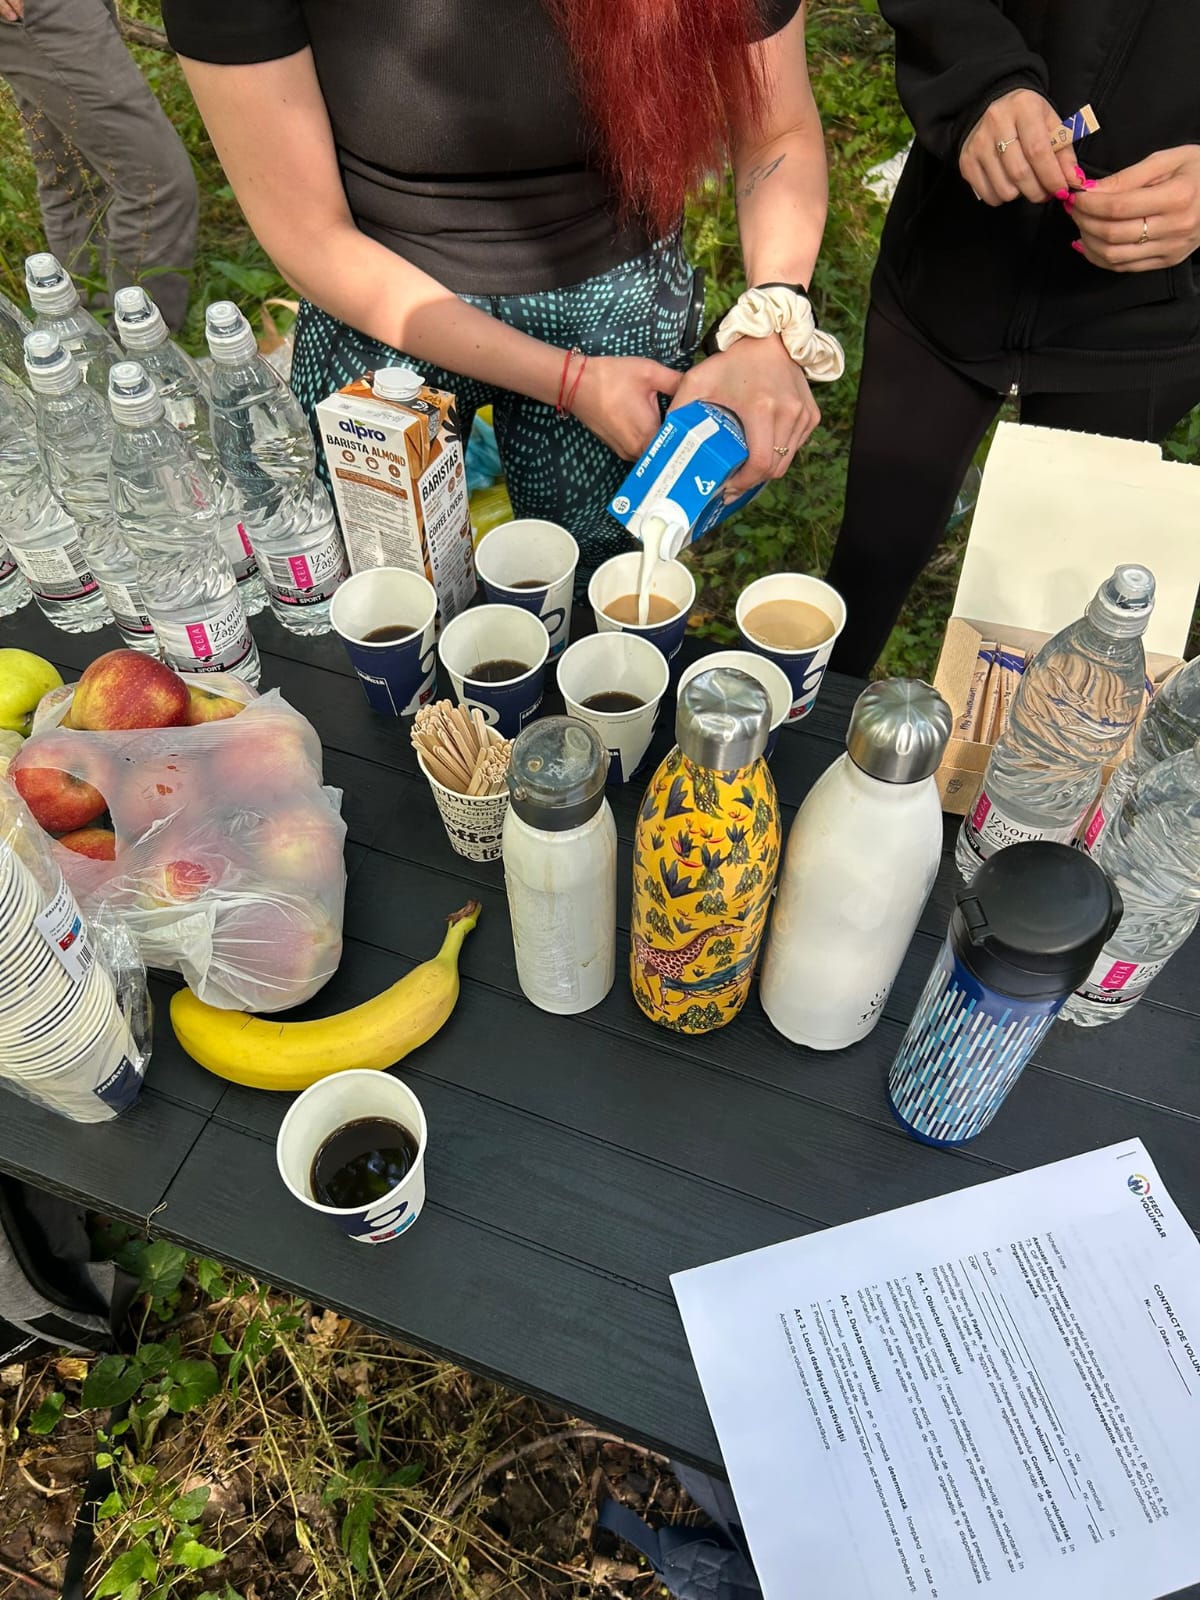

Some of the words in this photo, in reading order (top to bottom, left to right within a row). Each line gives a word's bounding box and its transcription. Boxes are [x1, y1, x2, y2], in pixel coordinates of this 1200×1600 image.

[339, 418, 386, 442] alpro
[326, 434, 369, 455] BARISTA
[371, 447, 406, 467] ALMOND
[422, 450, 458, 502] BARISTAS
[636, 456, 652, 478] MILCH
[429, 513, 447, 539] COFFEE
[447, 491, 464, 516] LOVERS
[295, 559, 307, 583] KEIA
[299, 594, 322, 604] SPORT
[209, 602, 241, 632] Izvoru
[194, 627, 207, 652] KEIA
[445, 823, 502, 843] offe
[990, 812, 1043, 841] Izvorul
[482, 848, 502, 859] te
[1108, 966, 1131, 985] KEIA
[1087, 992, 1119, 1002] SPORT
[97, 1059, 128, 1095] LAVAZZA
[1140, 1197, 1167, 1239] VOLUNTAR
[1147, 1195, 1165, 1218] EFECT
[1045, 1264, 1059, 1283] Efect
[1151, 1283, 1181, 1329] CONTRACT
[1182, 1341, 1200, 1375] VOLUN
[848, 1317, 864, 1344] Durata
[858, 1344, 882, 1393] contractului
[937, 1326, 963, 1375] contractului
[801, 1331, 815, 1355] Locul
[826, 1402, 847, 1443] activității
